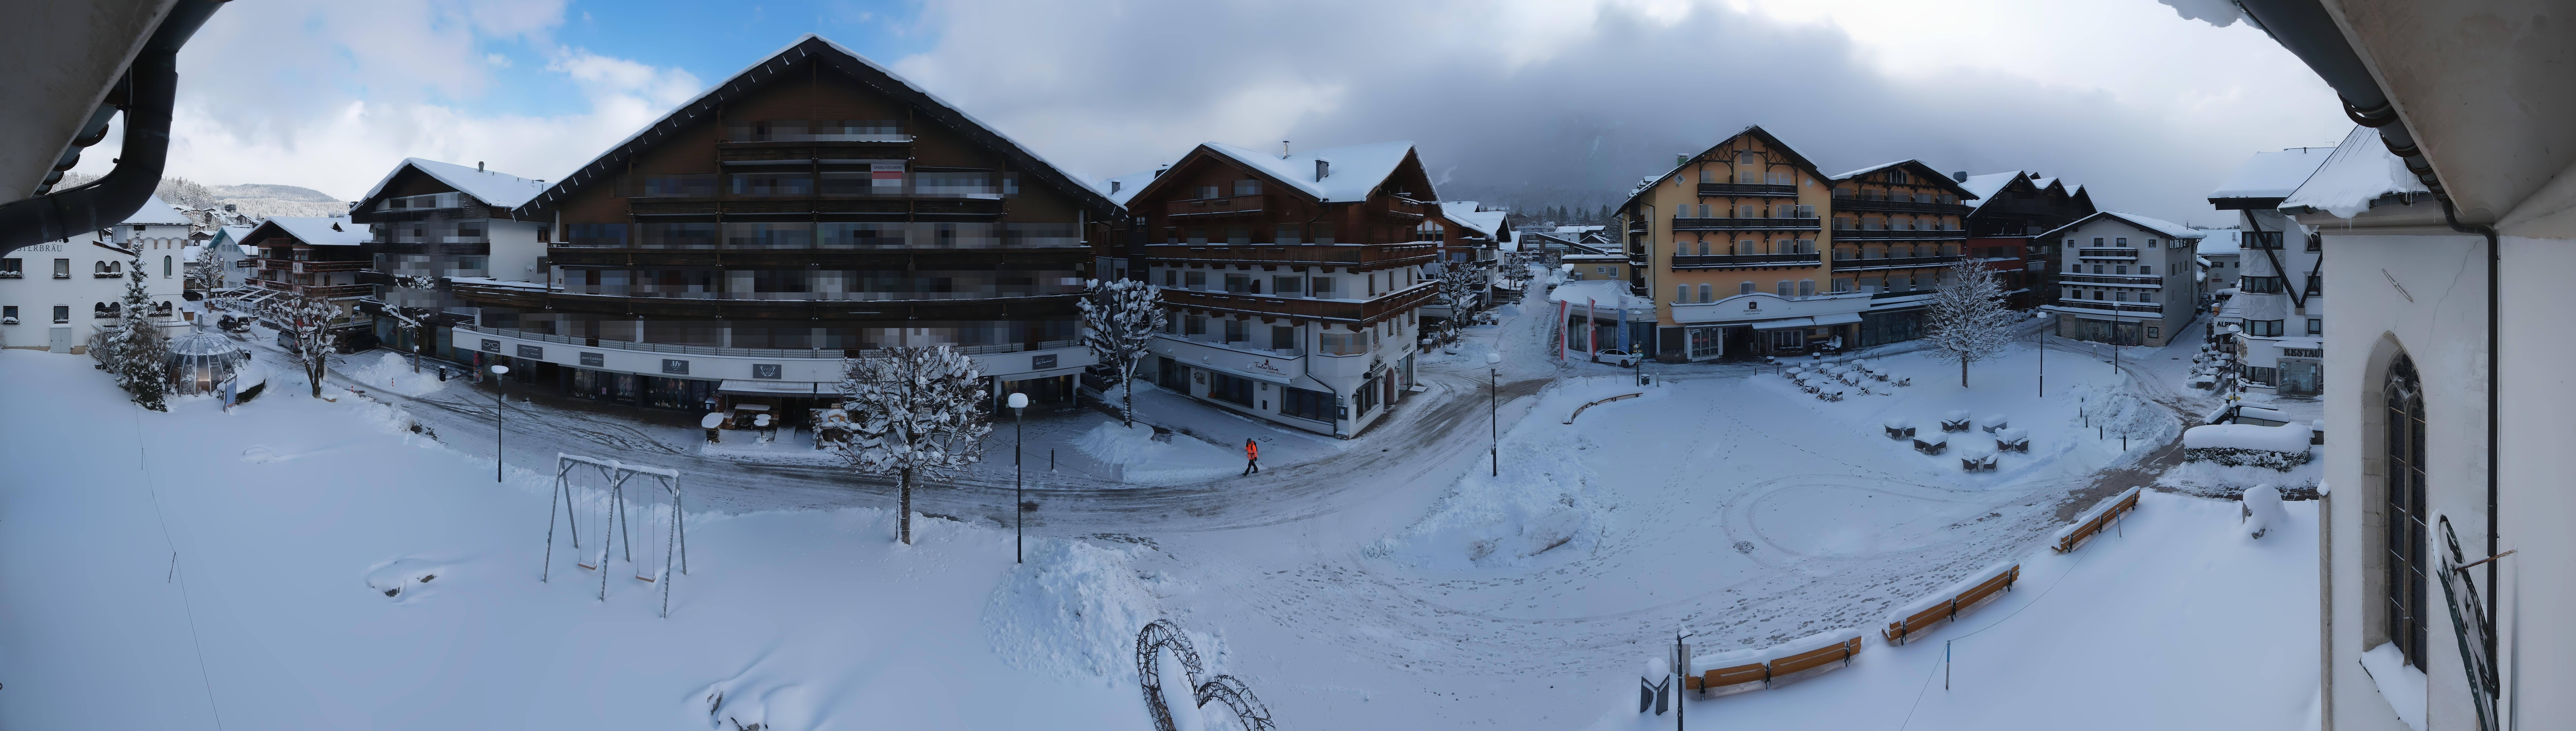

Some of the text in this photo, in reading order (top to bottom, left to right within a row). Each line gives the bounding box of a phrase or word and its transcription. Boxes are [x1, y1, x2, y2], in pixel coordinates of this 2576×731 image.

[1402, 343, 1410, 352] SAILER
[670, 361, 681, 370] My
[1371, 364, 1385, 377] RESTAURANT
